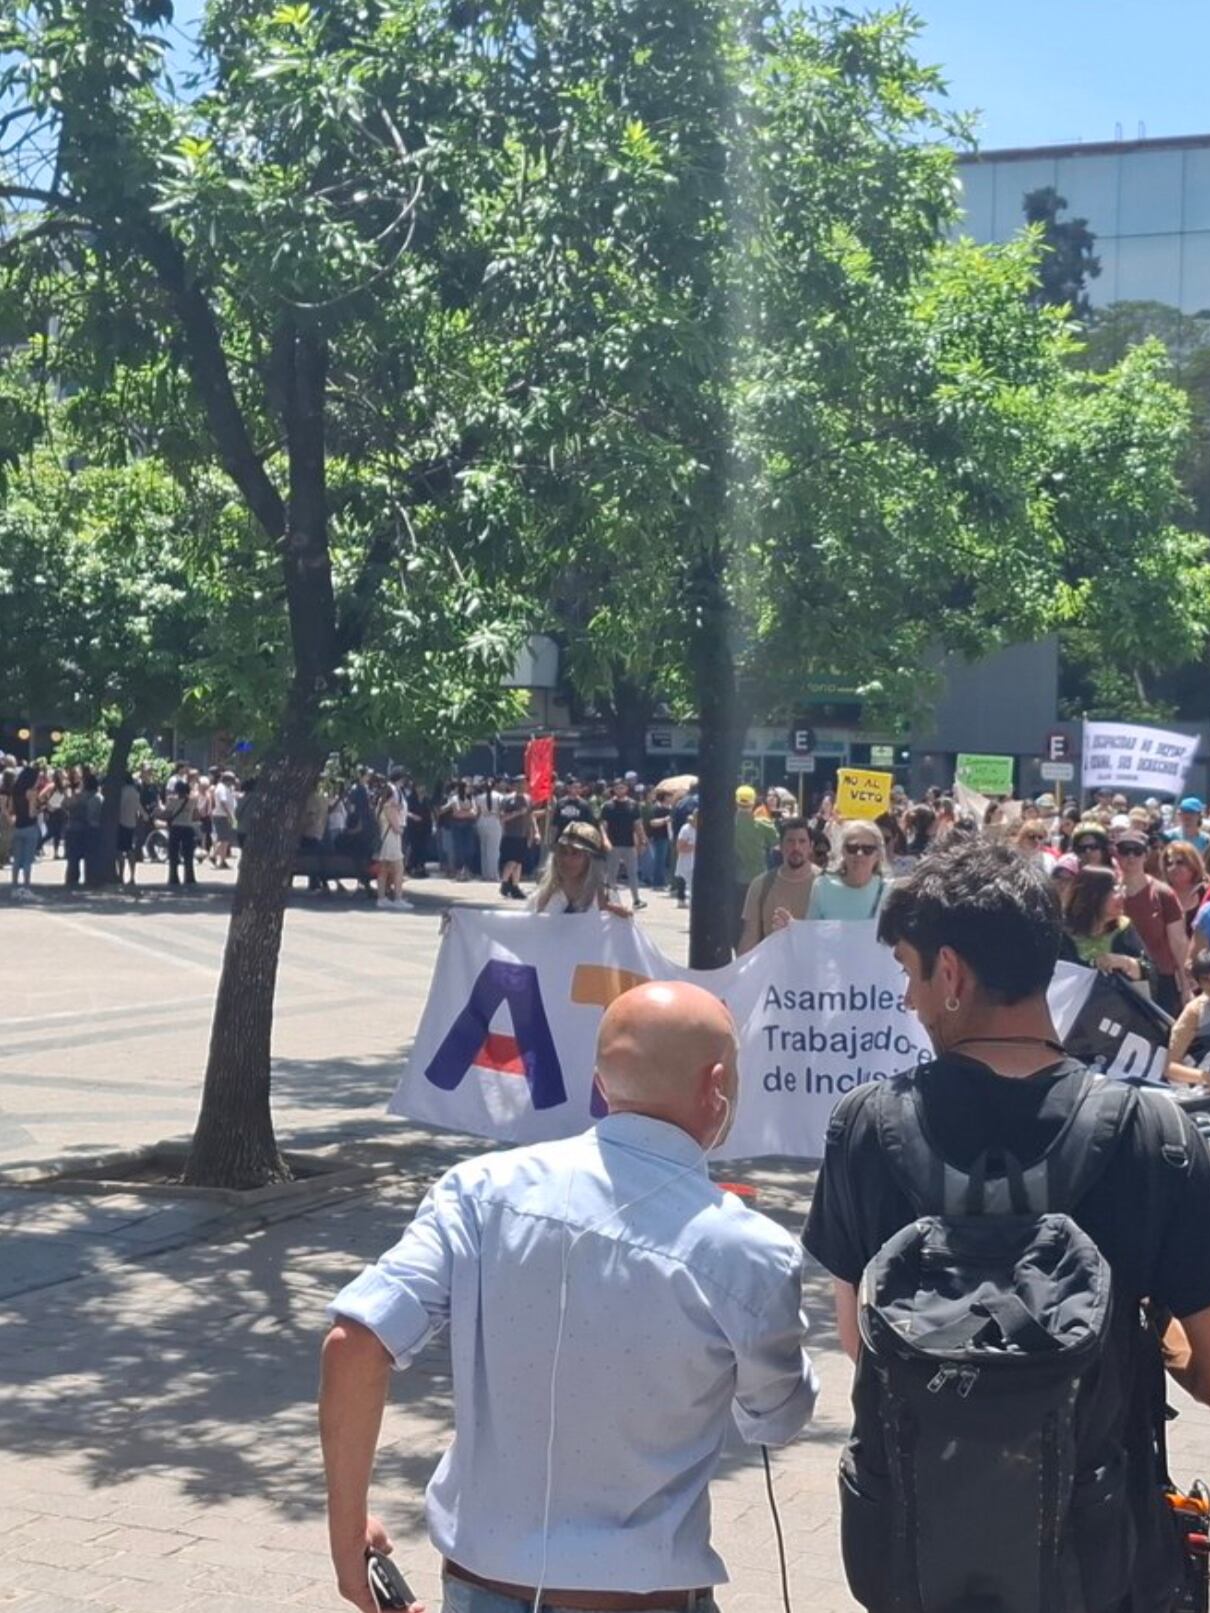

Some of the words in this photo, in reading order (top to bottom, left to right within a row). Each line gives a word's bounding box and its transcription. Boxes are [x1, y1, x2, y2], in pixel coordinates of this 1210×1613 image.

[795, 731, 808, 749] E
[843, 775, 858, 787] NO
[864, 778, 880, 789] AL
[850, 790, 884, 803] VETO
[763, 1066, 796, 1092] de
